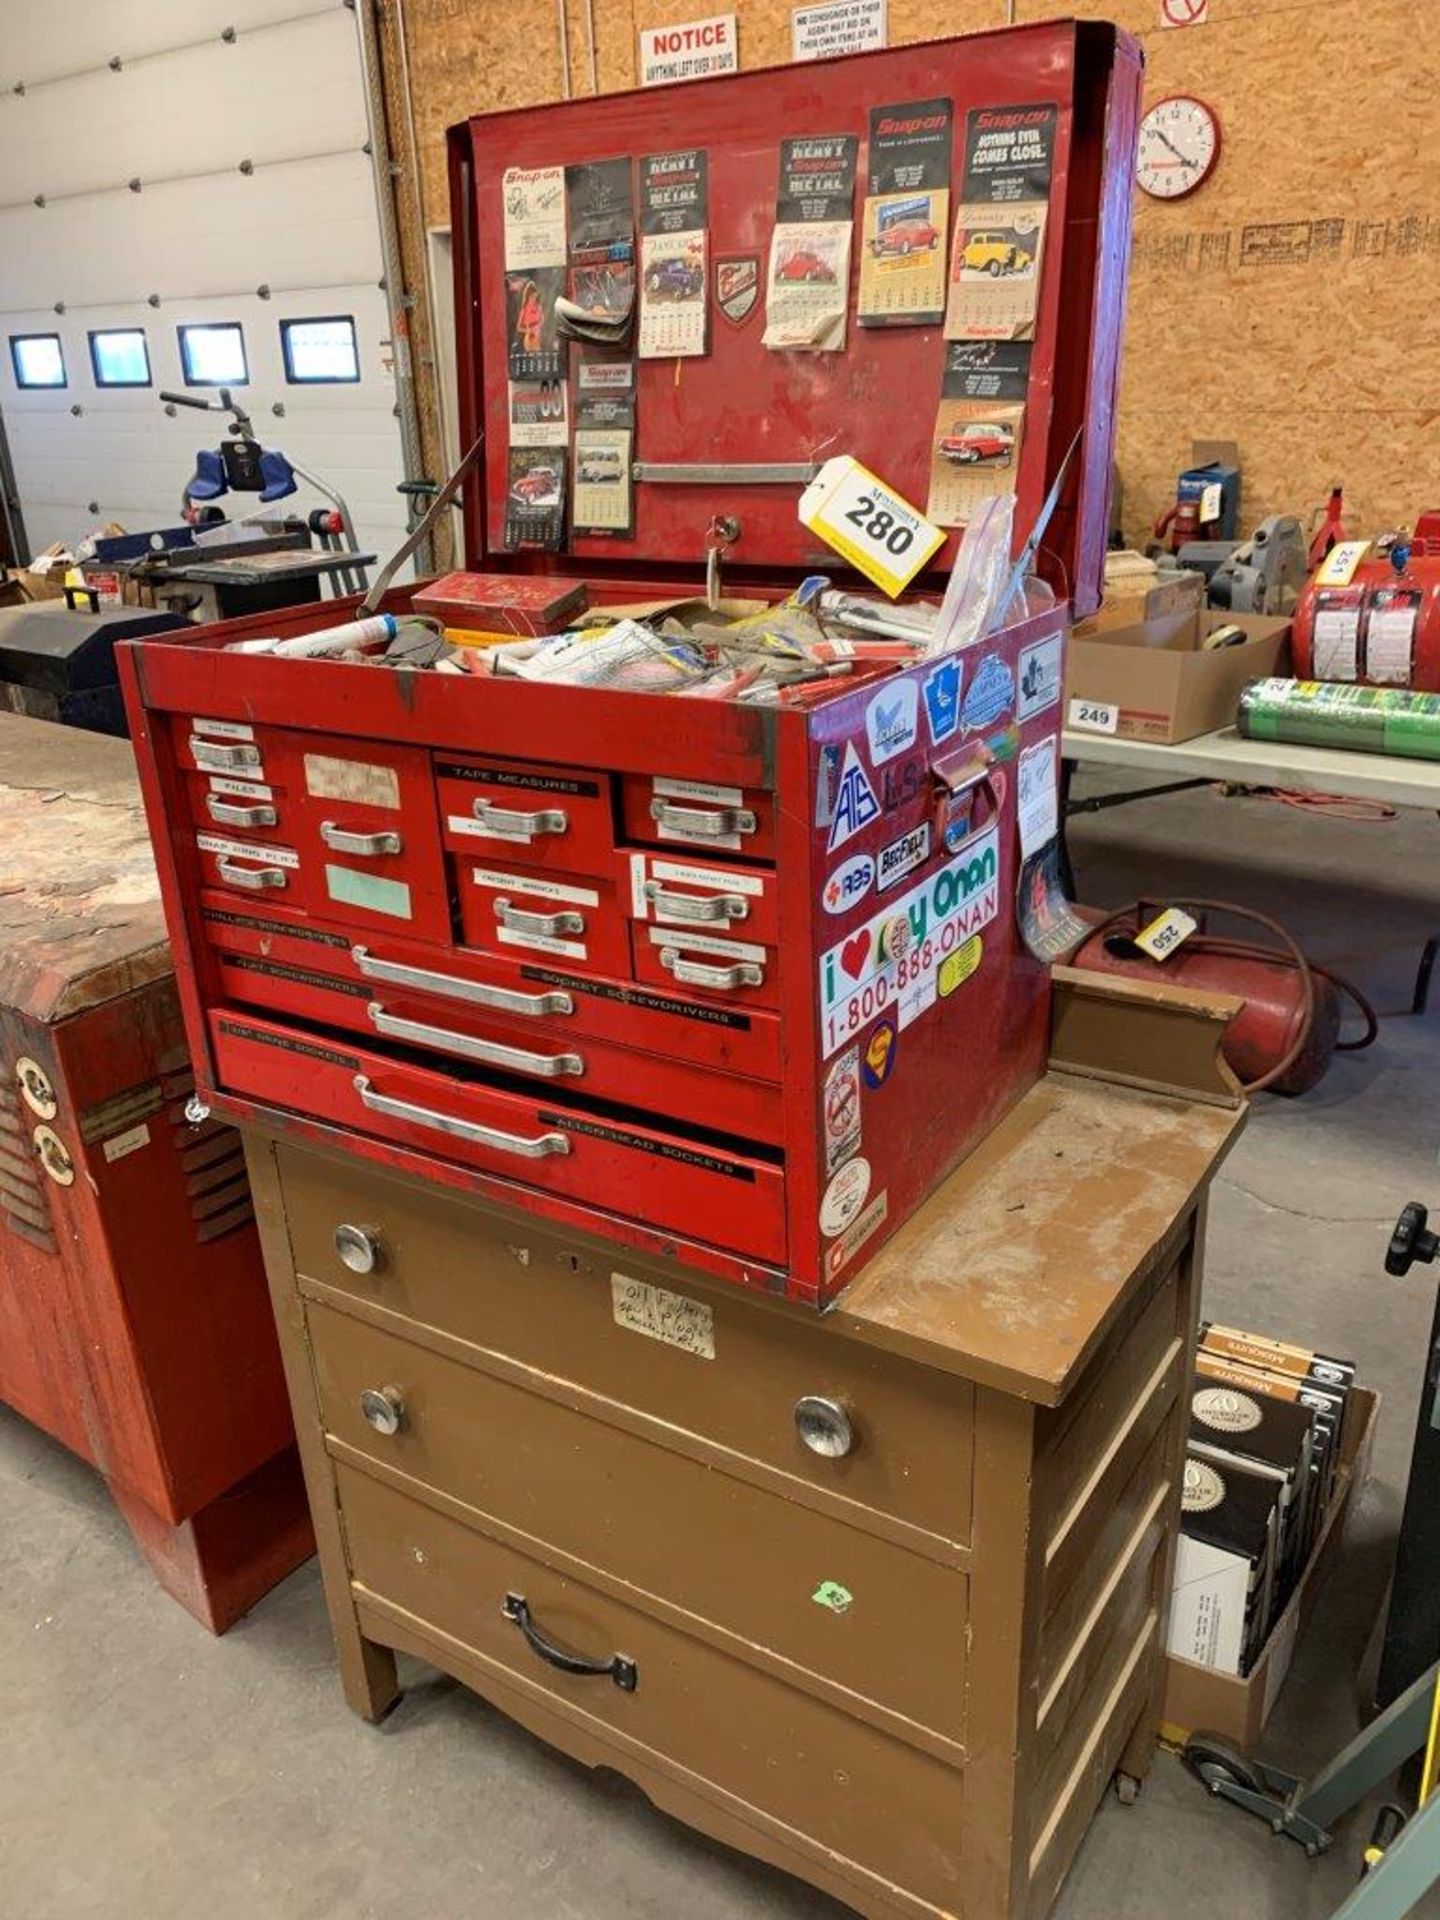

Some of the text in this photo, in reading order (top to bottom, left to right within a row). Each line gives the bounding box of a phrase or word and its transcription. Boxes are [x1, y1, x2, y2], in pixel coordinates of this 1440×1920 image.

[654, 24, 727, 55] NOTICE
[678, 60, 693, 78] LEFT
[876, 115, 947, 135] Snap-on
[974, 110, 1050, 128] Snap-on
[972, 146, 1008, 164] COMES
[505, 170, 561, 184] Snap-on
[845, 496, 915, 556] 280
[1331, 549, 1355, 574] 251
[1078, 707, 1109, 725] 249
[224, 782, 256, 795] FILES
[453, 767, 579, 793] TAPE MEASURES
[830, 766, 882, 849] ATS
[933, 846, 996, 918] Onan
[1152, 924, 1179, 950] 250
[828, 888, 996, 1048] 1-800-888-ONAN
[541, 972, 731, 1024] SOCKET SCREWDRIVERS
[556, 1118, 734, 1173] ALLEN HEAD SOCKETS
